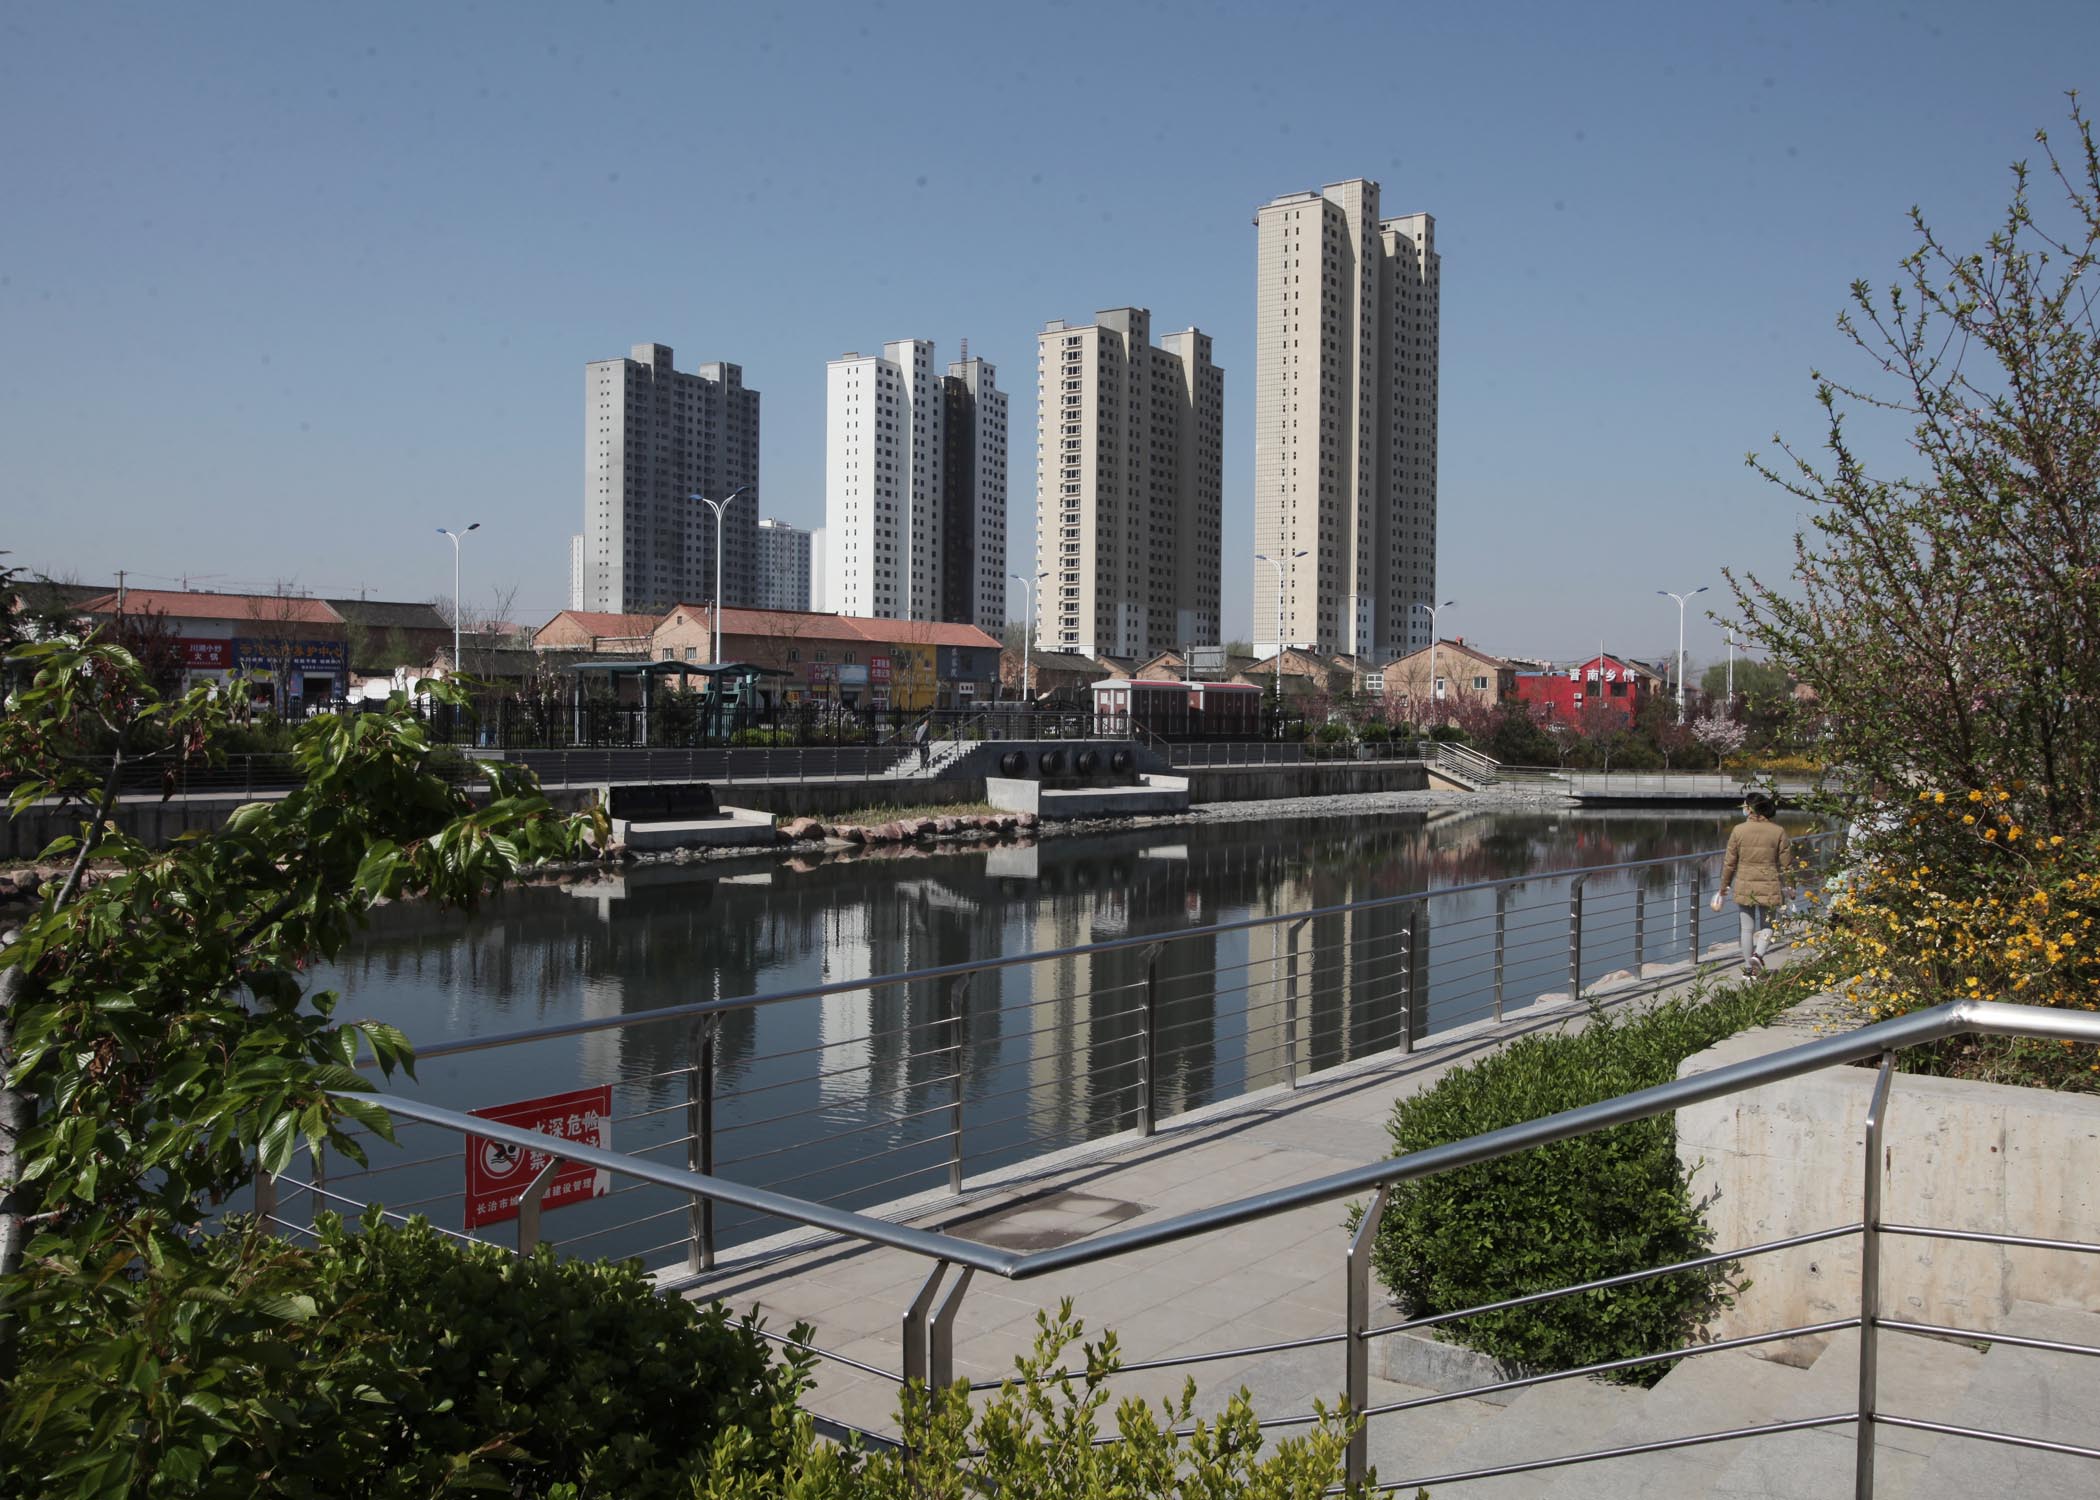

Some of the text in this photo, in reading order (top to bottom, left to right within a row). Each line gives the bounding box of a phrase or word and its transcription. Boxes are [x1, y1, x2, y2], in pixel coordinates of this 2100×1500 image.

[1568, 668, 1636, 682] 晋南乡情
[530, 1109, 599, 1137] 水深危险
